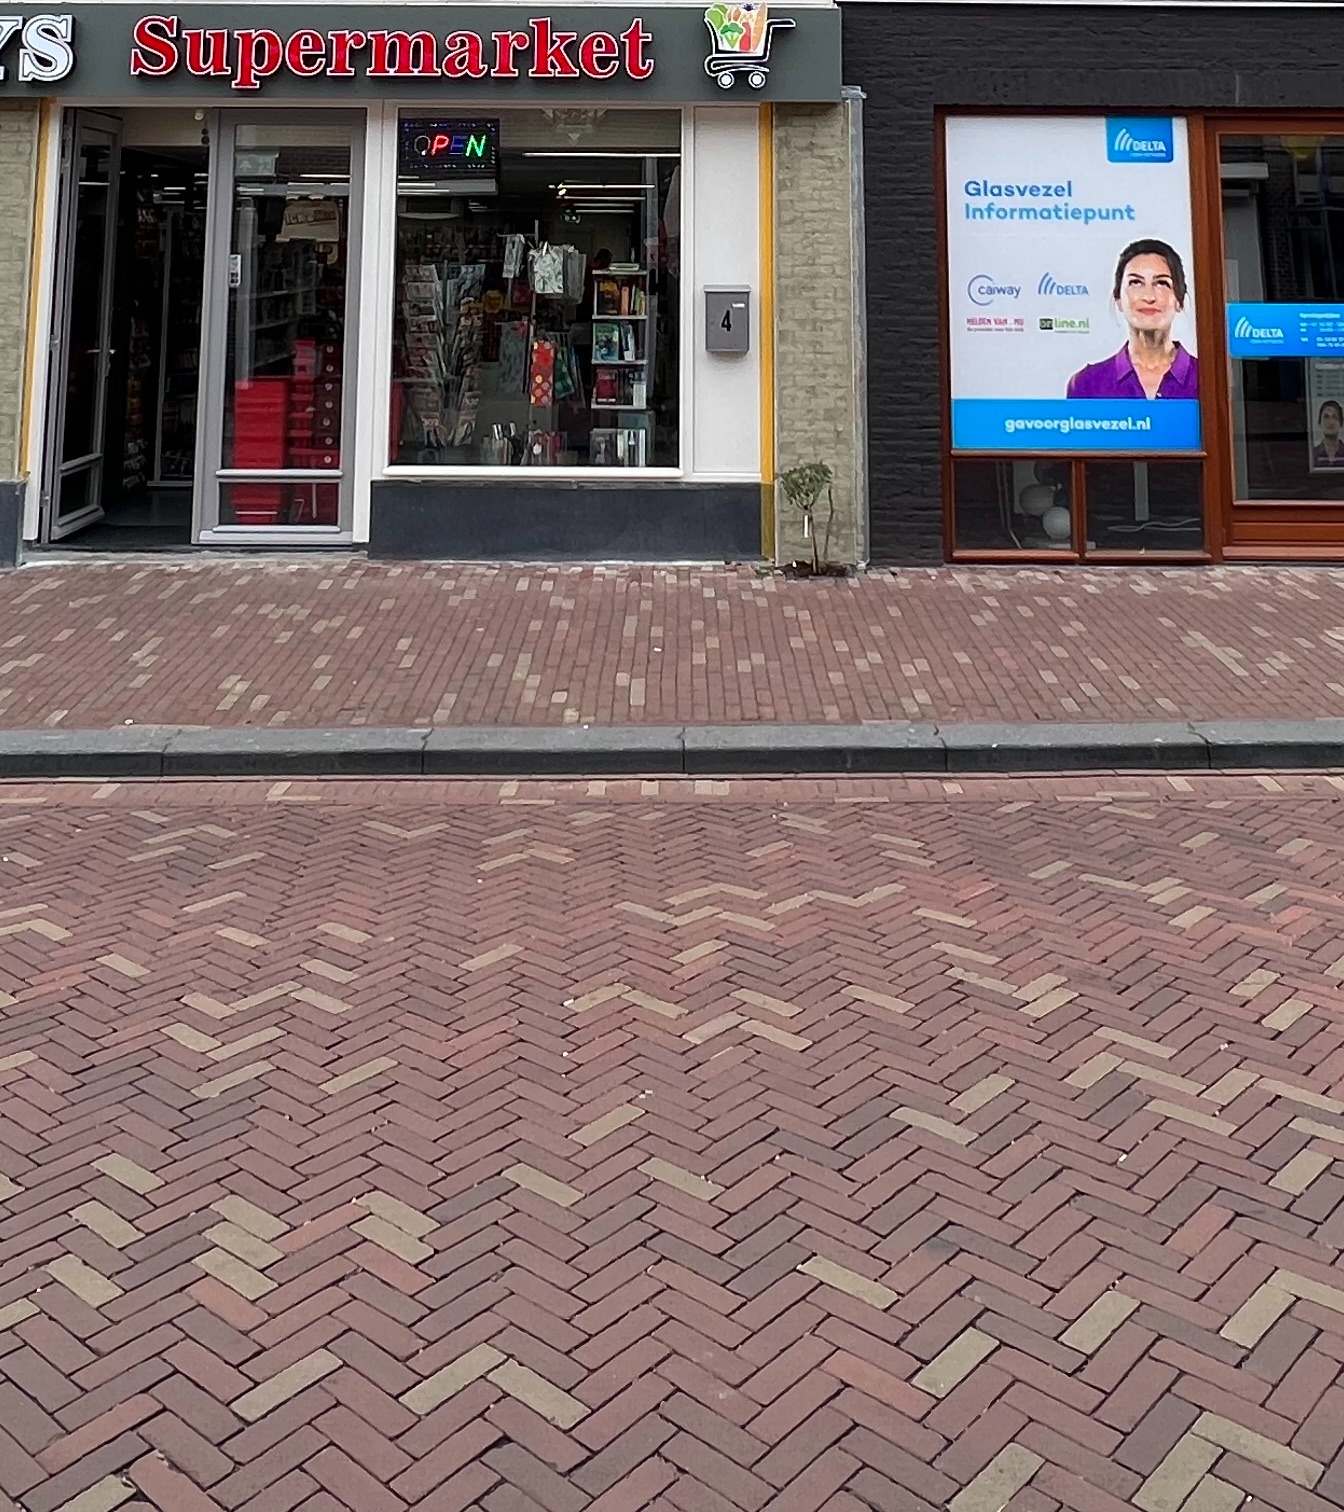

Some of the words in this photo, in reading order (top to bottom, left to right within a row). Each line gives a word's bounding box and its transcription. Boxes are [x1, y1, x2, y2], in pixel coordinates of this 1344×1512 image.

[130, 15, 654, 88] Supermarket
[414, 134, 487, 157] OPEN
[1132, 140, 1167, 152] DELTA
[964, 180, 1073, 197] Glasvezel
[964, 202, 1136, 225] Informatiepunt
[1056, 285, 1089, 295] DELTA
[720, 309, 732, 332] 4
[1252, 328, 1284, 338] DELTA
[1005, 416, 1151, 433] gavoorglasvezel.nl
